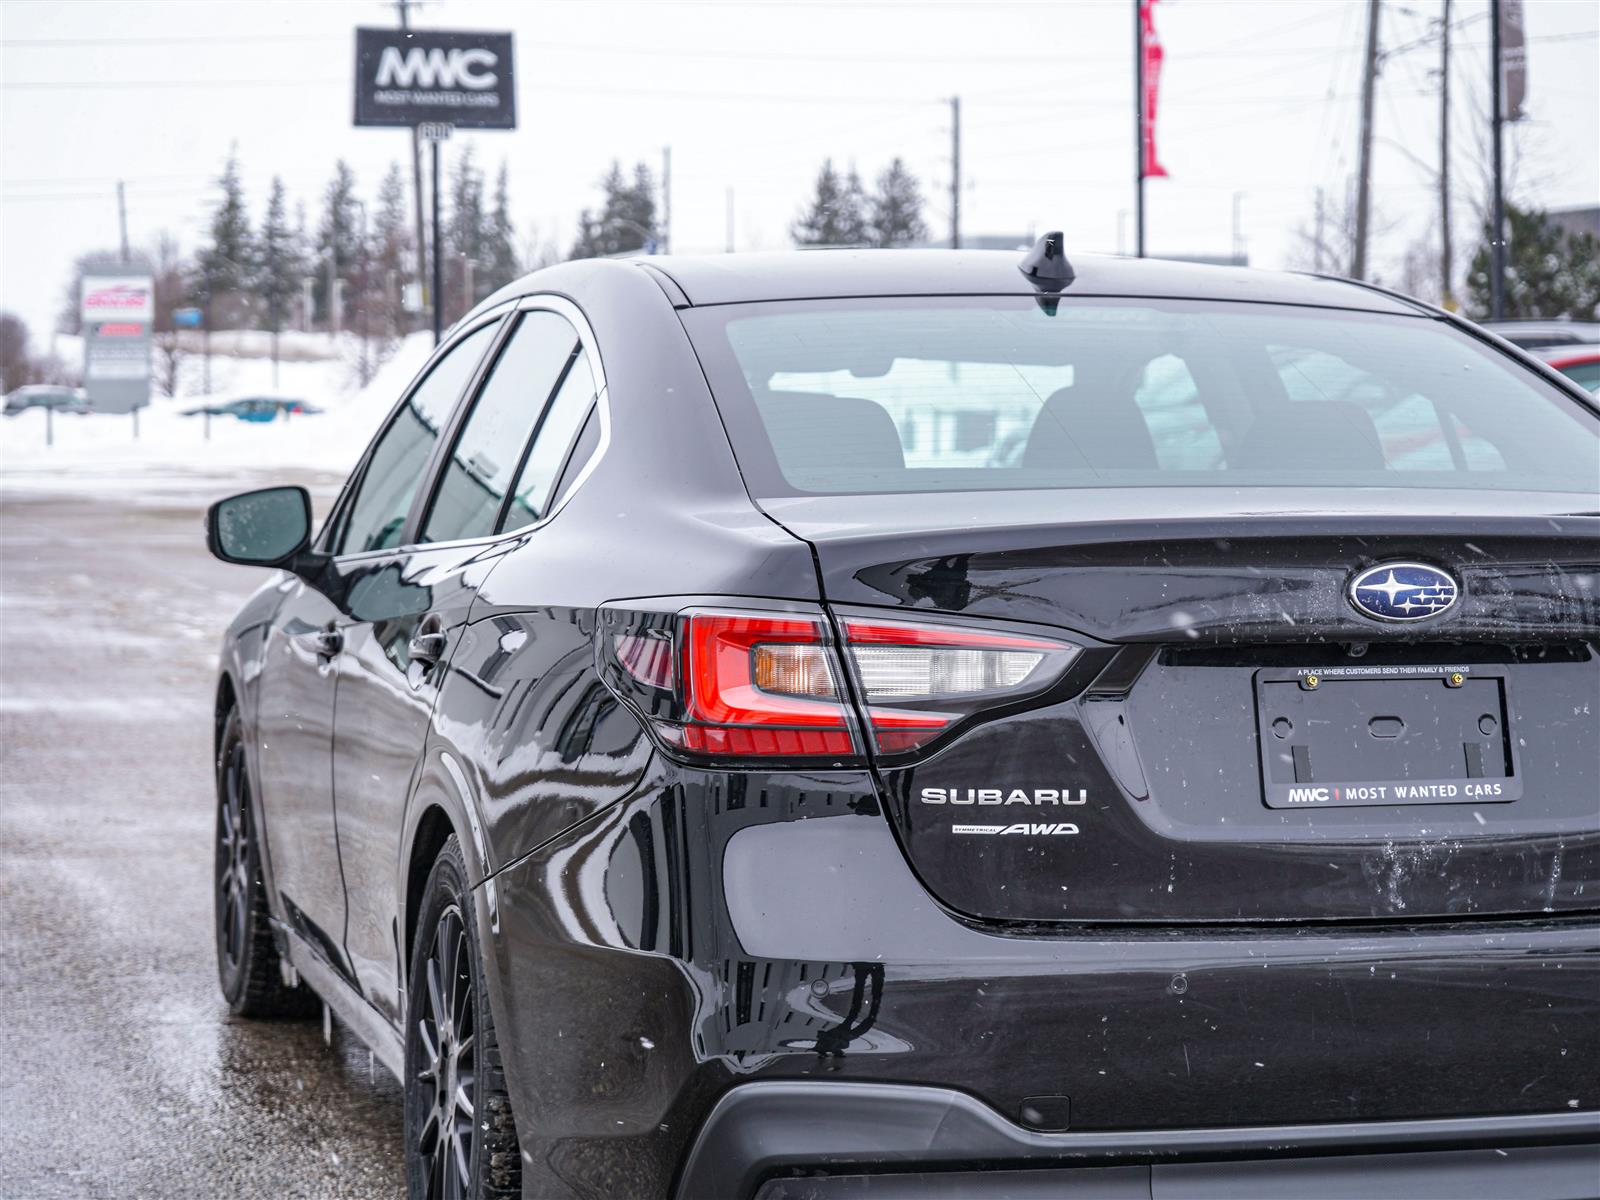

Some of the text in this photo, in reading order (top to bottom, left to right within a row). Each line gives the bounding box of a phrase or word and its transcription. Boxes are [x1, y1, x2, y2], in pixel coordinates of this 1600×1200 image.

[375, 46, 499, 89] MWC
[374, 90, 411, 105] MOST
[413, 90, 465, 106] WANTED
[1346, 667, 1382, 675] CUSTOMERS
[921, 788, 1087, 806] SUBARU
[1288, 783, 1502, 802] MWC MOST WANTED CARS
[1000, 823, 1080, 835] AWD
